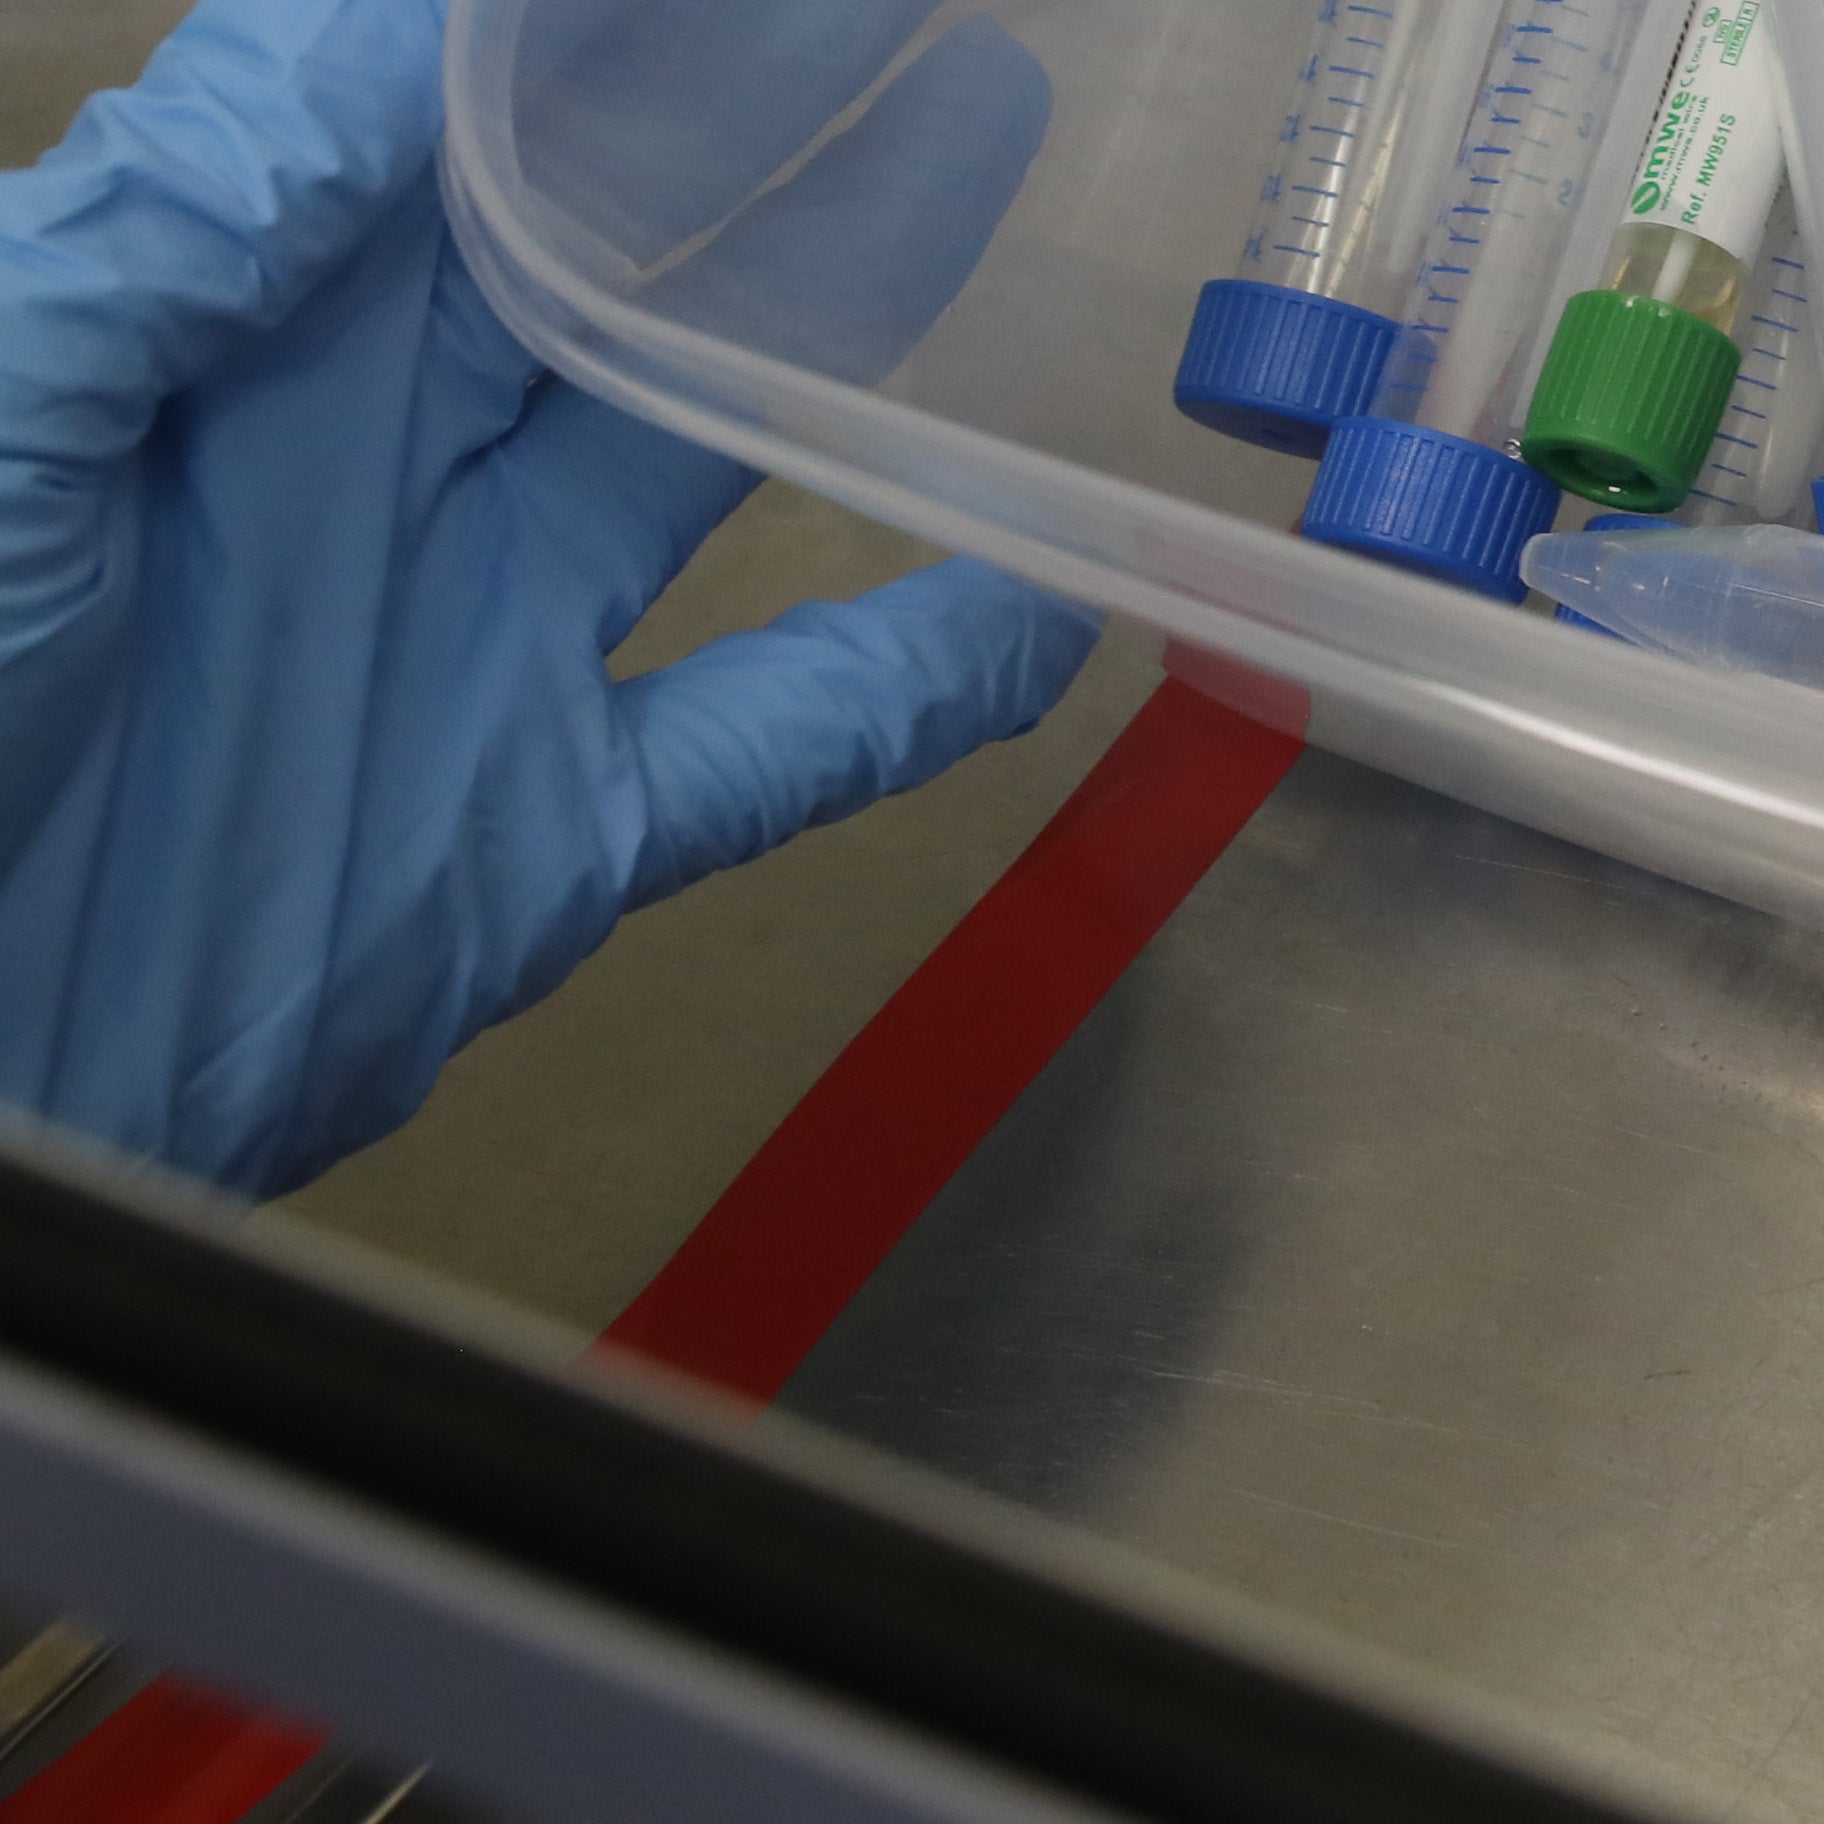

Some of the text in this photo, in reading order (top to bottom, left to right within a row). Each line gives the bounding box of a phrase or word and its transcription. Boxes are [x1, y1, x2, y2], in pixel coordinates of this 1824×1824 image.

[1645, 91, 1690, 179] mwe
[1683, 112, 1736, 225] Ref. MW951S
